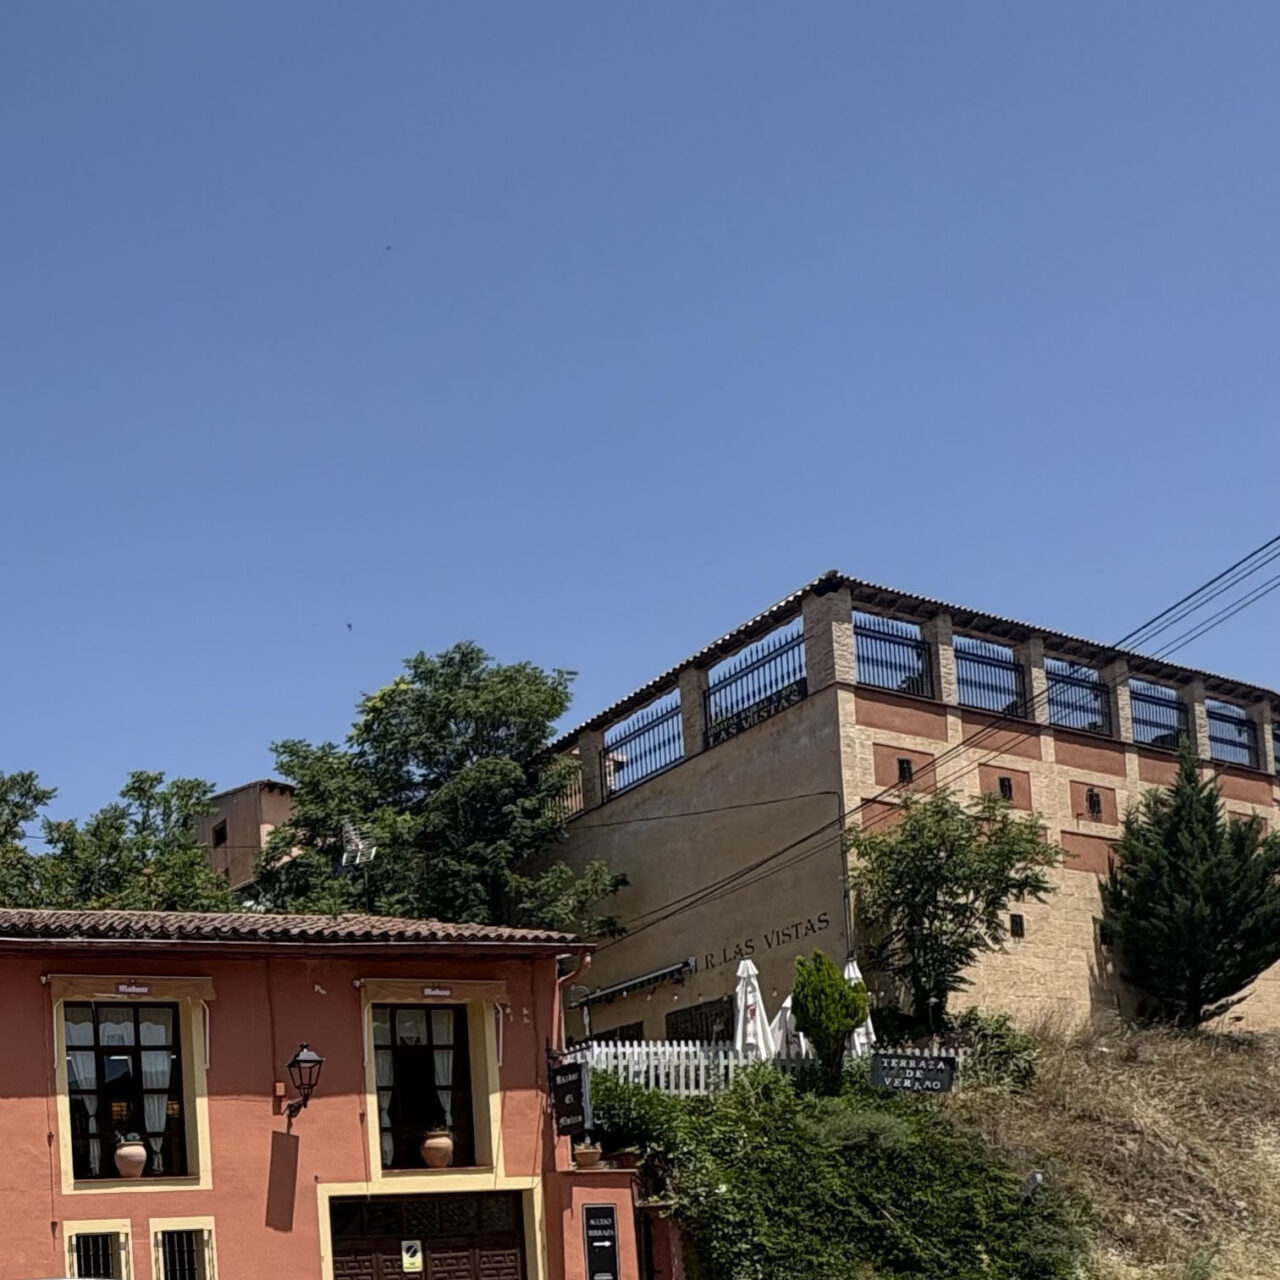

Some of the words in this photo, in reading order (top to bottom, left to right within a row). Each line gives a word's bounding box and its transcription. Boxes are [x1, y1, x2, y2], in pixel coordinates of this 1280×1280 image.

[709, 723, 737, 747] LAS
[741, 693, 799, 728] VISTAS
[722, 939, 755, 964] LAS
[764, 912, 830, 950] VISTAS
[882, 1058, 946, 1070] TERRAZA
[905, 1069, 924, 1079] DE
[884, 1077, 942, 1091] VERANO
